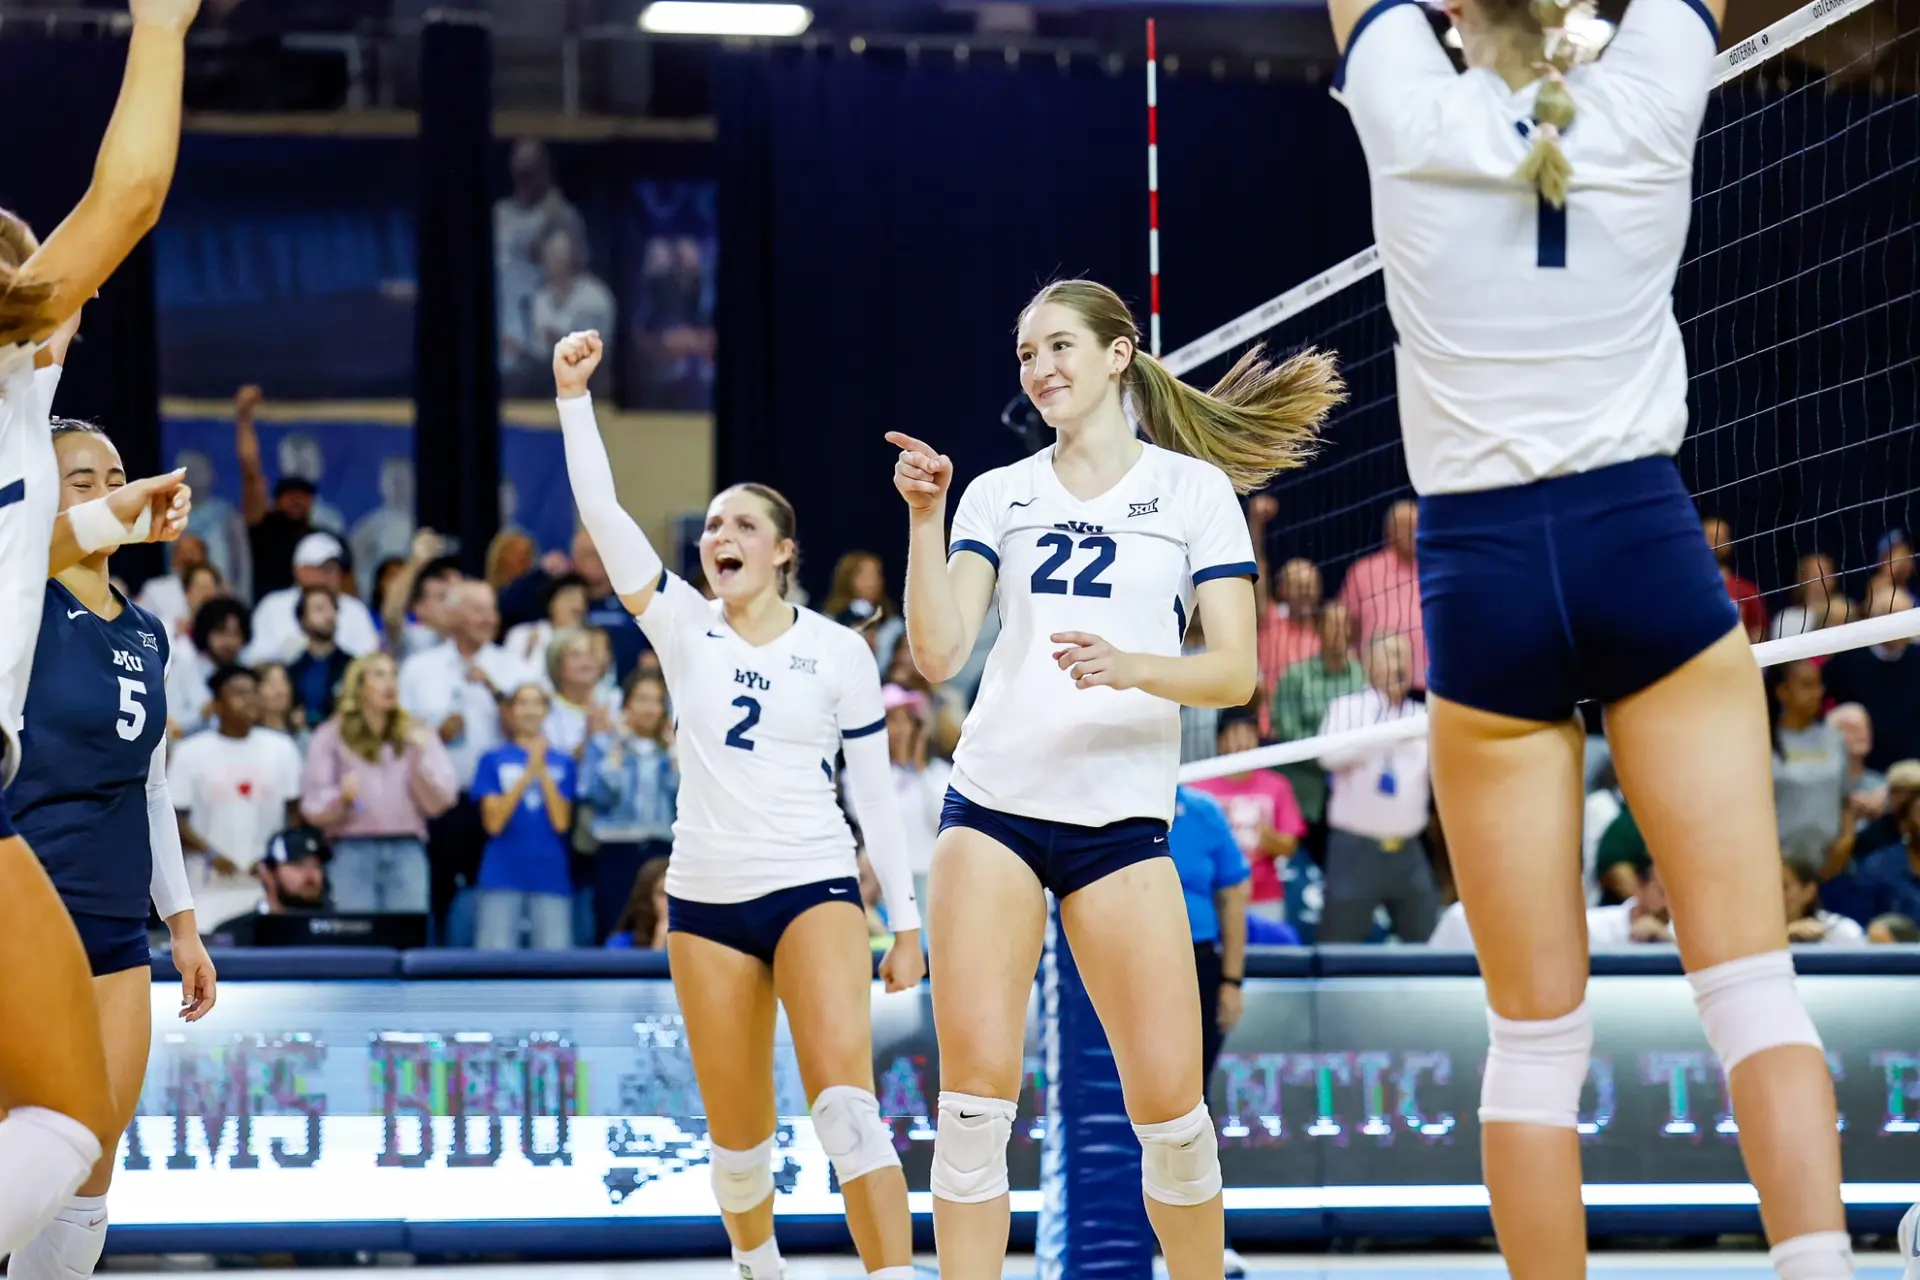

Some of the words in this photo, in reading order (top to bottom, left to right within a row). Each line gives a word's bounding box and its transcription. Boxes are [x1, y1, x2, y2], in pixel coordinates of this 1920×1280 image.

[1031, 532, 1117, 598] 22
[115, 675, 147, 741] 5
[725, 695, 762, 751] 2
